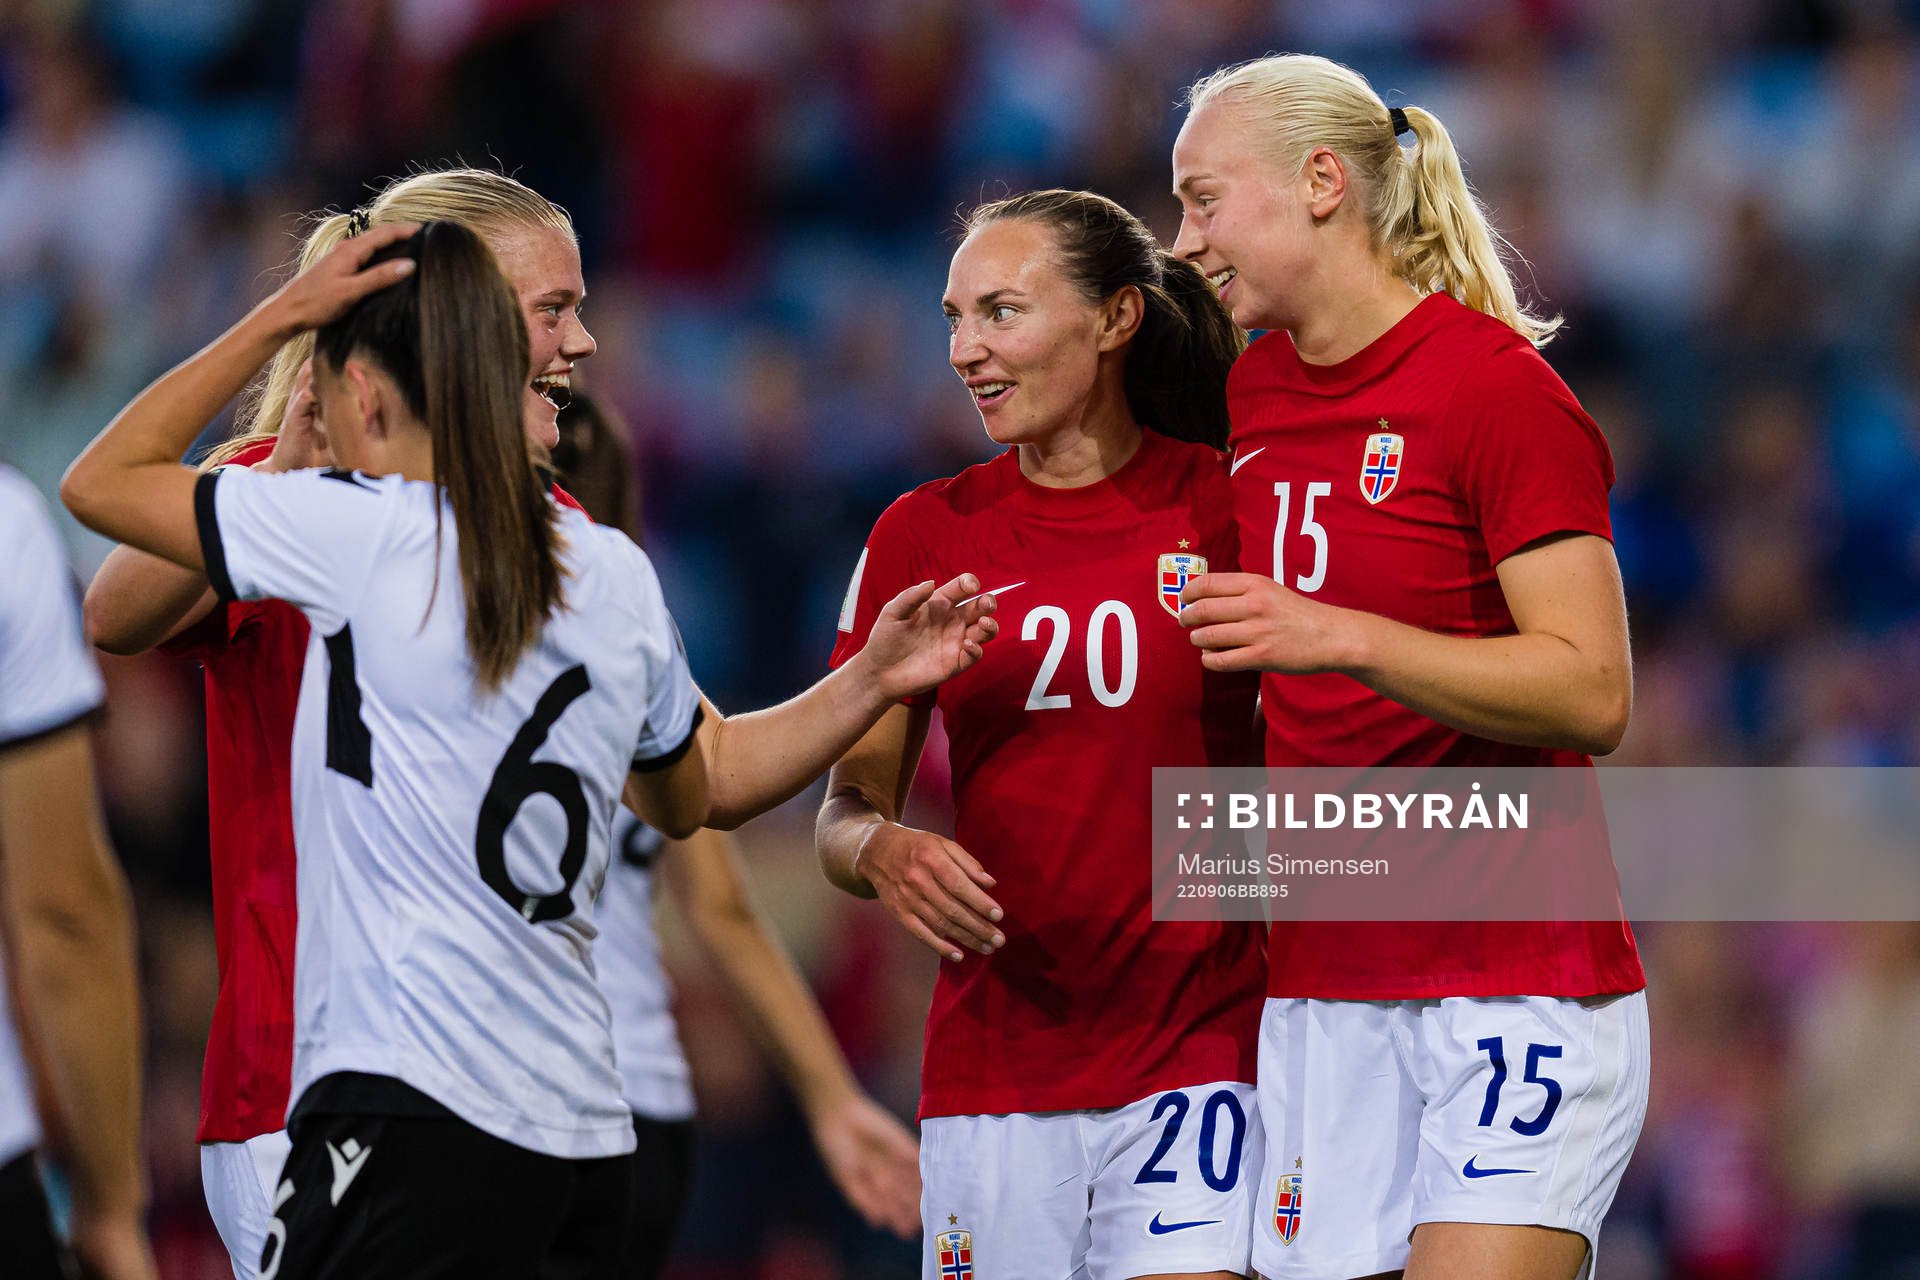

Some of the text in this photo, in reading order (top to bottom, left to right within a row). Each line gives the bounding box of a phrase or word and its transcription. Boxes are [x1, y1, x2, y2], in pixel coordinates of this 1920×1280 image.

[1274, 482, 1332, 593] 15
[1021, 600, 1139, 711] 20
[475, 664, 591, 924] 6
[1133, 1089, 1247, 1193] 20
[1477, 1036, 1563, 1137] 15
